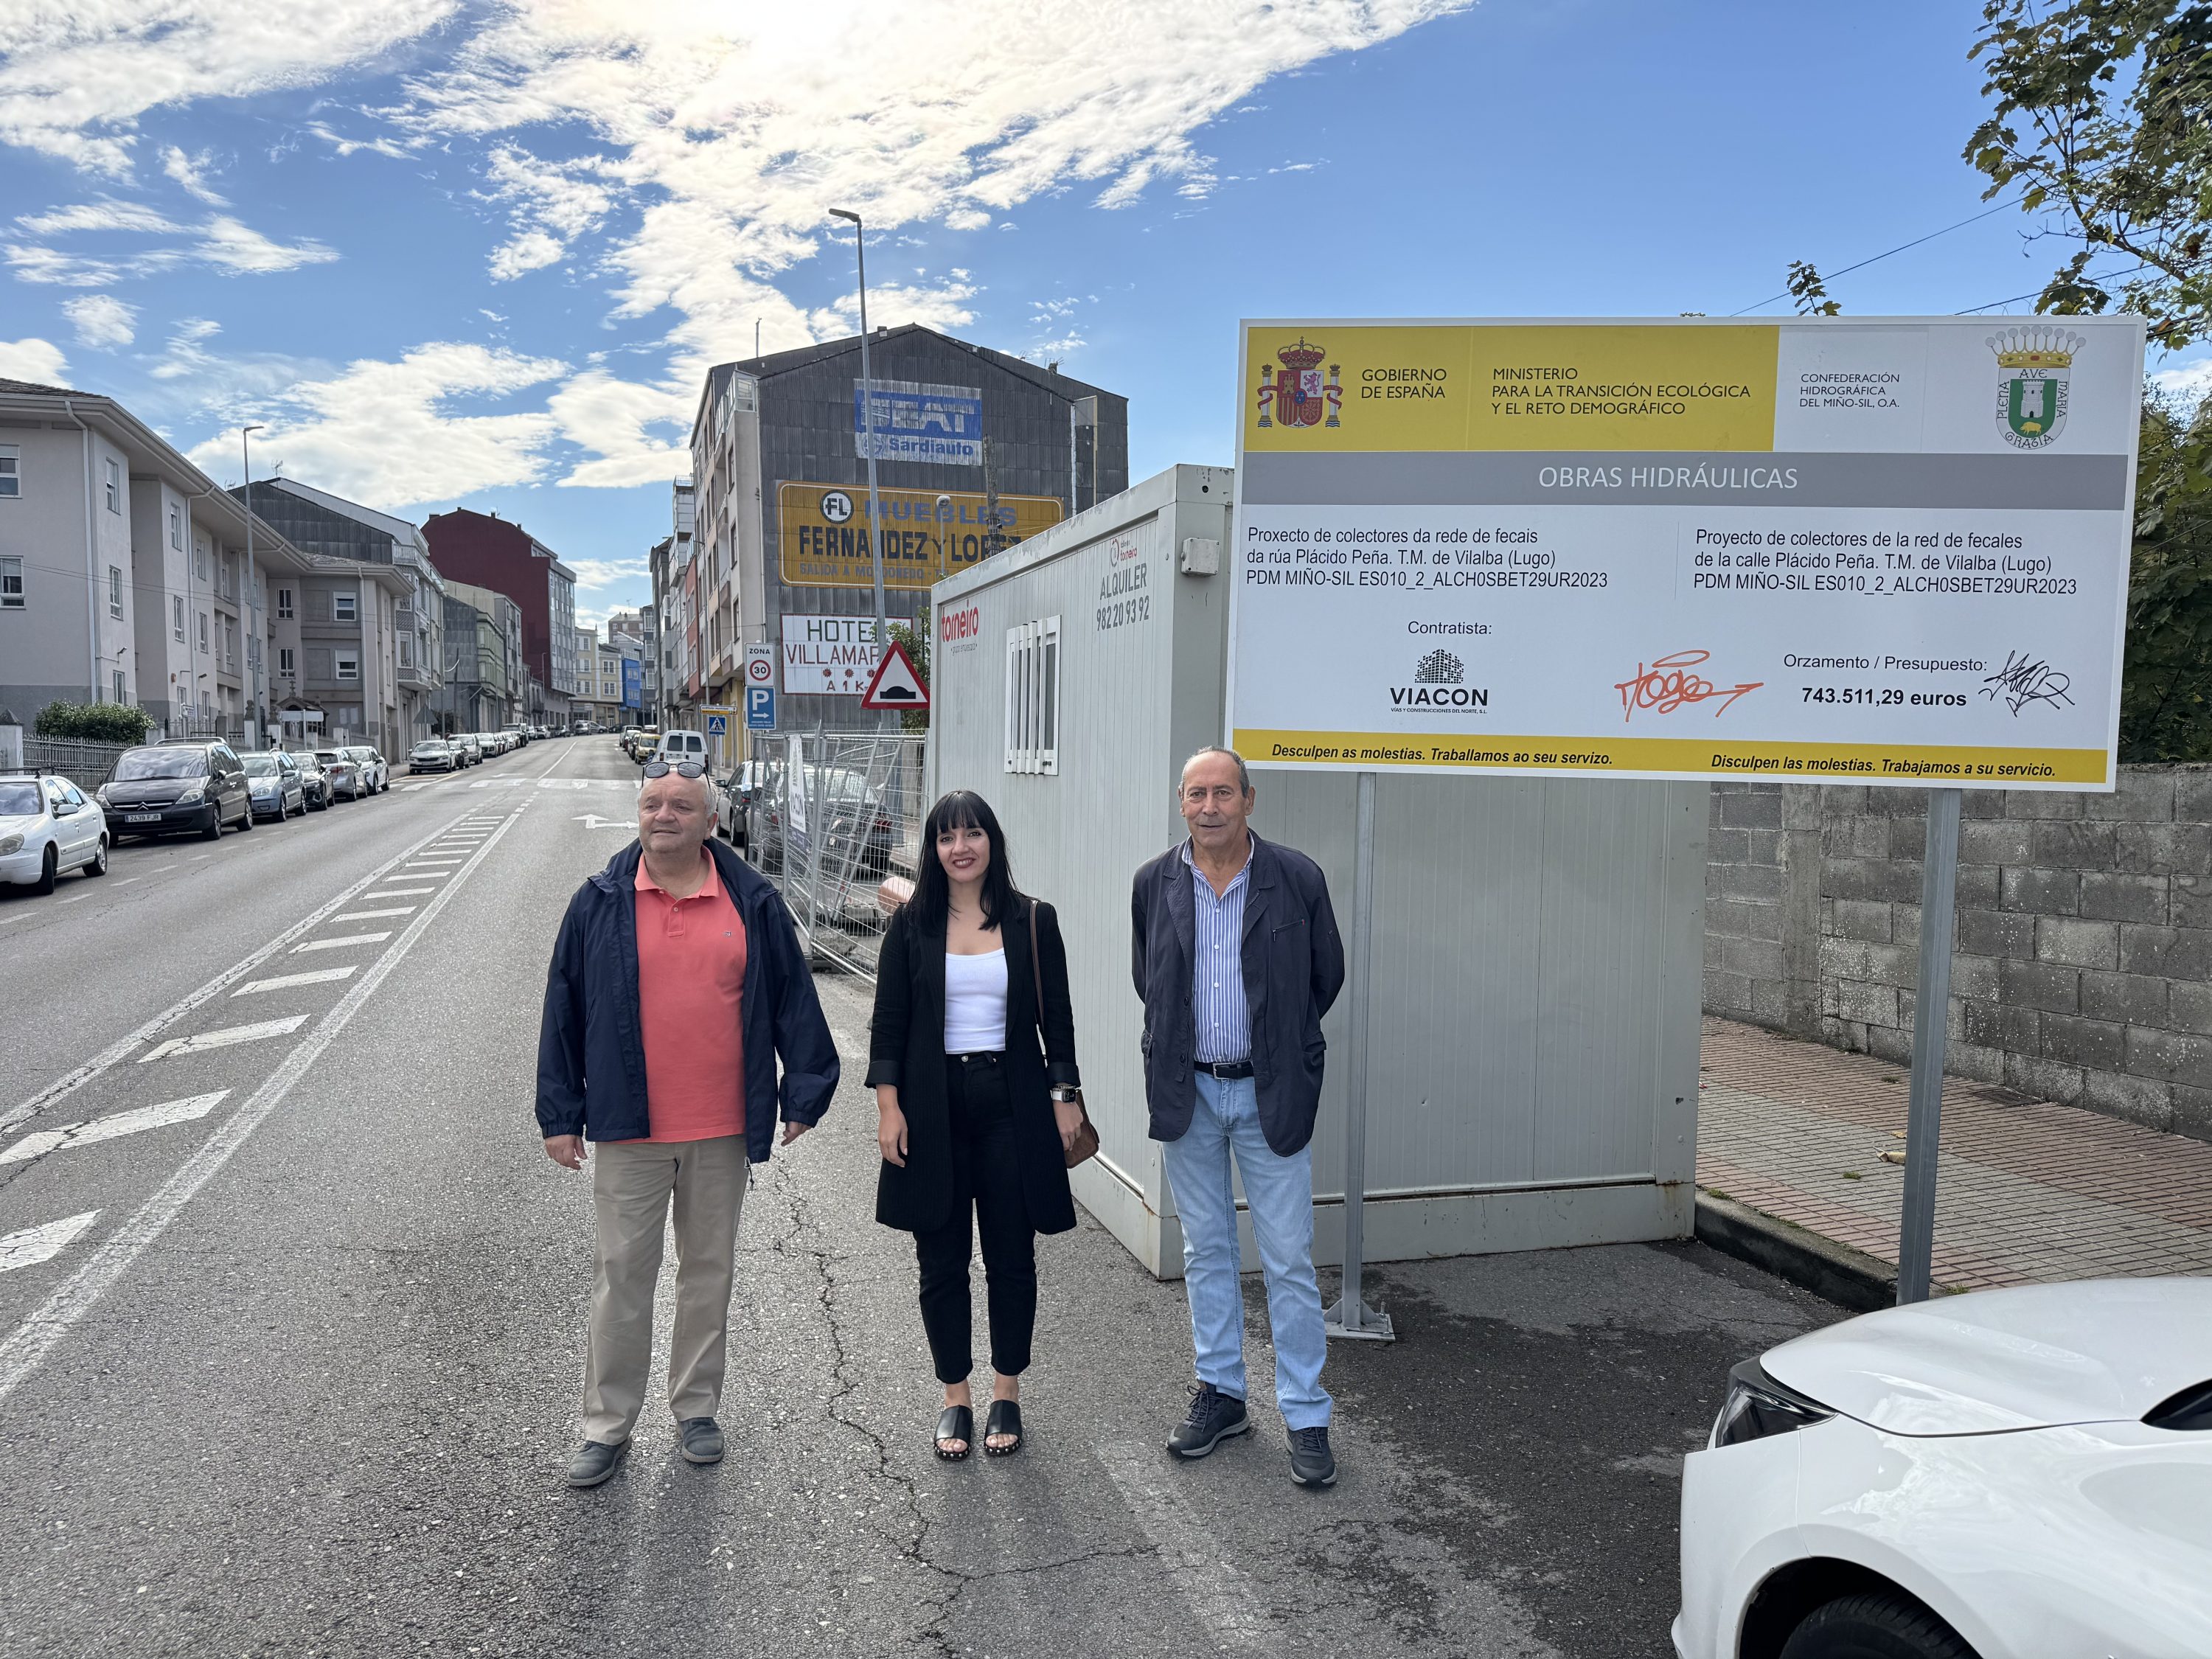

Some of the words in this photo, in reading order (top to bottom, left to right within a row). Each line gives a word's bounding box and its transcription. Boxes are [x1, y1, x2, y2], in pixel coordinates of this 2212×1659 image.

[1362, 369, 1447, 381] GOBIERNO
[1494, 368, 1577, 380] MINISTERIO
[1801, 372, 1899, 382] CONFEDERACIÓN
[2020, 369, 2047, 378] AVE
[1362, 386, 1382, 398] DE
[1388, 383, 1445, 398] ESPAÑA
[1493, 386, 1529, 397] PARA
[1536, 386, 1553, 397] LA
[1557, 383, 1651, 397] TRANSICIÓN
[1658, 383, 1750, 397] ECOLÓGICA
[1801, 384, 1885, 394] HIDROGRÁFICA
[1492, 403, 1500, 414] Y
[1506, 403, 1521, 414] EL
[1526, 403, 1565, 414] RETO
[1571, 400, 1685, 414] DEMOGRÁFICO
[1824, 397, 1874, 408] MIÑO-SIL,
[1878, 399, 1899, 407] O.A.
[1997, 381, 2009, 419] PLENA
[889, 439, 973, 456] Sardiauto
[1540, 467, 1621, 487] OBRAS
[1632, 462, 1798, 488] HIDRÁULICAS
[825, 498, 847, 515] FL
[1249, 527, 1309, 542] Proxecto
[1315, 528, 1331, 542] de
[1337, 528, 1408, 543] colectores
[1413, 528, 1430, 543] da
[1436, 529, 1467, 543] rede
[1473, 529, 1490, 543] de
[1495, 528, 1537, 543] fecais
[1697, 529, 1761, 548] Proyecto
[1767, 530, 1785, 545] de
[1791, 531, 1867, 546] colectores
[1873, 532, 1891, 546] de
[1897, 532, 1908, 546] la
[1915, 532, 1938, 547] red
[1944, 532, 1962, 547] de
[1968, 532, 2022, 548] fecales
[931, 538, 946, 554] Y
[1121, 546, 1137, 561] torneiro
[1248, 549, 1263, 563] da
[1270, 549, 1290, 563] rúa
[1297, 549, 1346, 563] Plácido
[1352, 550, 1391, 564] Peña.
[1398, 550, 1426, 564] T.M.
[1433, 550, 1450, 564] de
[1455, 550, 1502, 565] Vilalba
[1509, 550, 1555, 568] (Lugo)
[1695, 552, 1713, 566] de
[1719, 552, 1730, 566] la
[1736, 552, 1770, 567] calle
[1776, 552, 1829, 568] Plácido
[1836, 554, 1878, 568] Peña.
[1885, 554, 1915, 569] T.M.
[1921, 554, 1939, 569] de
[1946, 555, 1995, 570] Vilalba
[2003, 555, 2051, 574] (Lugo)
[800, 563, 838, 575] SALIDA
[843, 565, 849, 575] A
[1248, 570, 1280, 584] PDM
[1286, 568, 1354, 585] MIÑO-SIL
[1100, 563, 1147, 600] ALQUILER
[1694, 574, 1730, 588] PDM
[1736, 571, 1809, 590] MIÑO-SIL
[942, 599, 978, 642] torneiro
[1097, 606, 1111, 631] 982
[1113, 602, 1123, 627] 20
[1127, 599, 1136, 625] 93
[1139, 596, 1149, 621] 92
[807, 620, 877, 642] HOTE
[1408, 622, 1492, 634] Contratista:
[1784, 654, 1868, 668] Orzamento
[1885, 656, 1986, 673] Presupuesto:
[827, 681, 835, 691] A
[843, 681, 847, 691] 1
[752, 690, 769, 710] P
[1390, 688, 1487, 706] VIACON
[1803, 688, 1903, 706] 743.511,29
[1911, 694, 1966, 706] euros
[1272, 744, 1338, 760] Desculpen
[1342, 749, 1357, 758] as
[1361, 747, 1425, 759] molestias.
[1432, 748, 1509, 762] Traballamos
[1514, 754, 1528, 762] ao
[1533, 754, 1557, 762] seu
[1561, 752, 1612, 764] servizo.
[1711, 755, 1778, 771] Disculpen
[1784, 757, 1803, 769] las
[1807, 758, 1875, 771] molestias.
[1882, 759, 1960, 776] Trabajamos
[1965, 765, 1972, 773] a
[1977, 765, 1993, 774] su
[1997, 763, 2055, 776] servicio.
